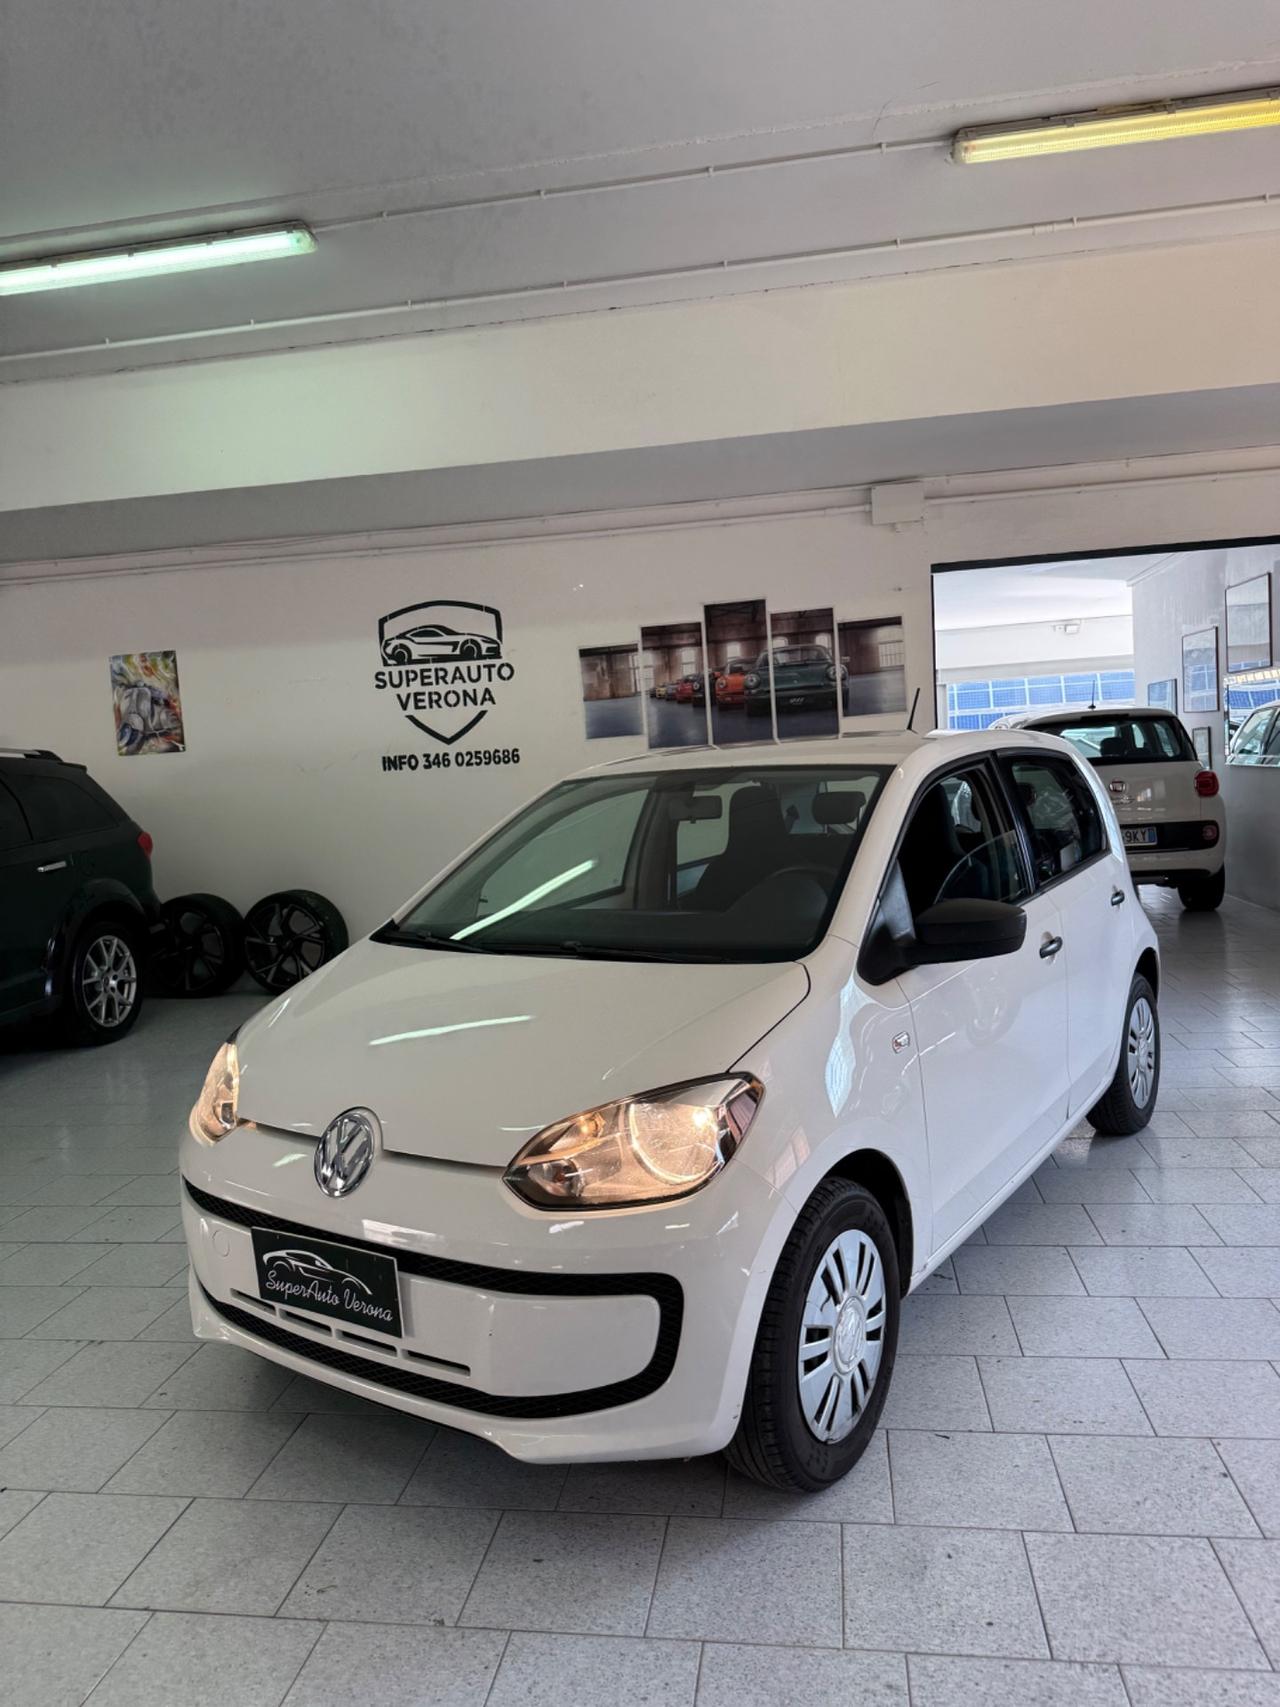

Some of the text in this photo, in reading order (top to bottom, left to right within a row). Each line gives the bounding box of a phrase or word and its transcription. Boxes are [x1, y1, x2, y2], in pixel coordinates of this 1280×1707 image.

[374, 662, 515, 690] SUPERAUTO
[396, 687, 496, 711] VERONA
[382, 748, 520, 772] INFO 346 0259686
[265, 1270, 393, 1322] SuperAuto Verona
